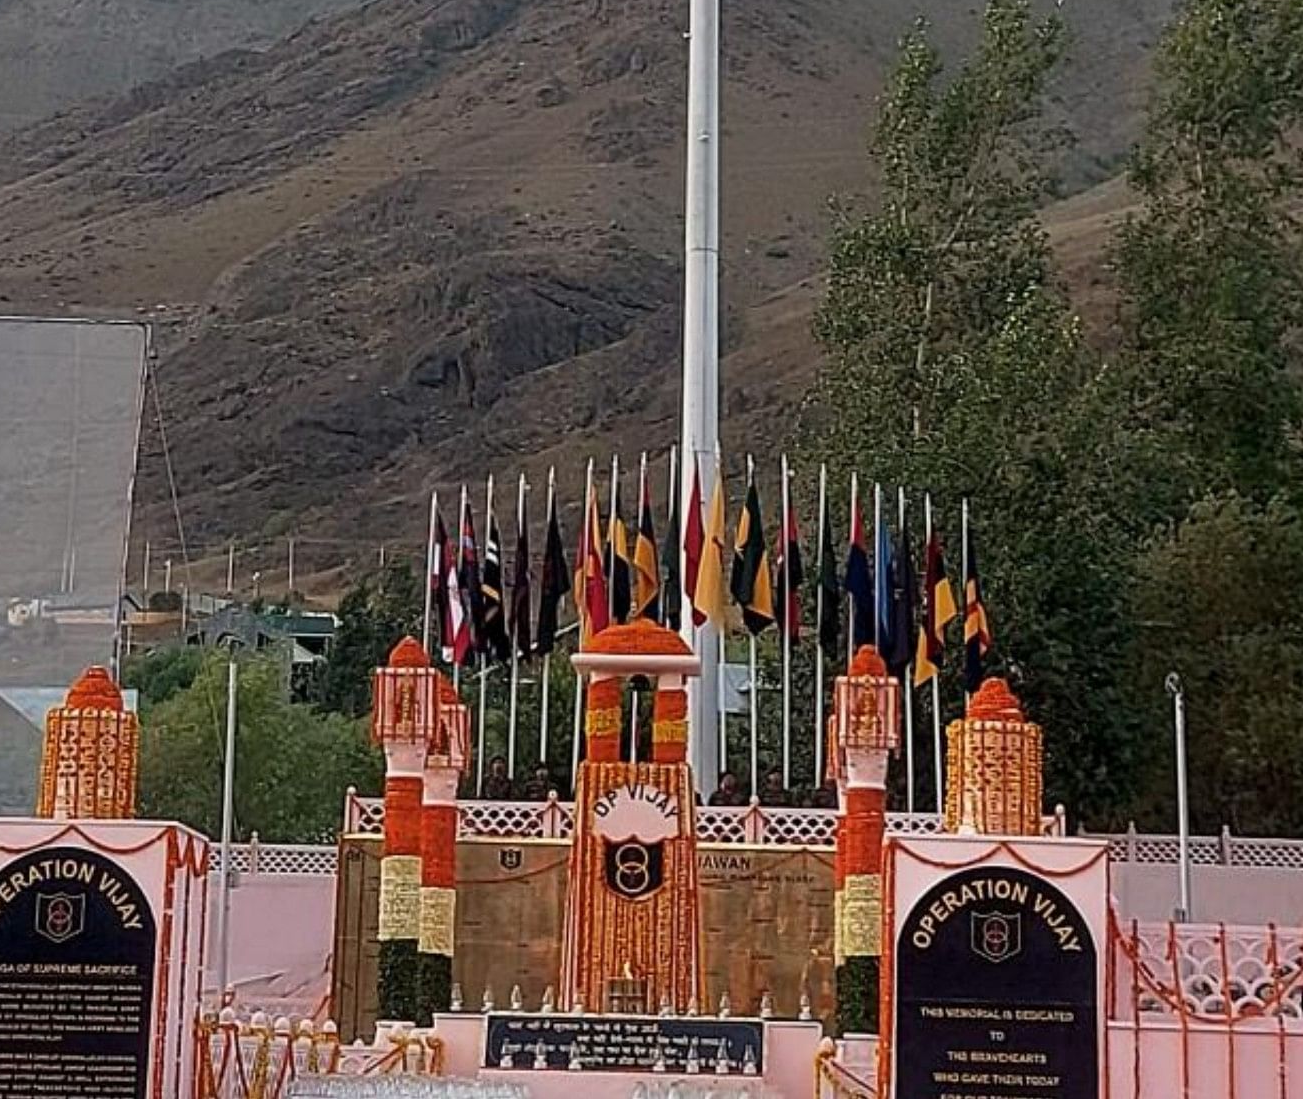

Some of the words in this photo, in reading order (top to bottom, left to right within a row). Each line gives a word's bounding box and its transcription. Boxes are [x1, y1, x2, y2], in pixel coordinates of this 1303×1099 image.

[593, 790, 618, 818] OP
[626, 783, 680, 819] VIJAY
[98, 872, 144, 931] VIJAY
[912, 878, 1029, 950] OPERATION
[1033, 892, 1083, 953] VIJAY
[16, 963, 31, 974] OF
[33, 963, 82, 975] SUPREME
[84, 964, 138, 976] SACRIFICE
[920, 1006, 945, 1019] THIS
[945, 1007, 1001, 1020] MEMORIAL
[1003, 1009, 1013, 1021] IS
[1015, 1009, 1075, 1023] DEDICATED
[989, 1030, 1005, 1042] TO
[947, 1050, 968, 1062] THE
[970, 1051, 1047, 1065] BRAVEHEARTS
[932, 1071, 960, 1083] WHO
[961, 1073, 991, 1085] GAVE
[993, 1074, 1024, 1086] THEIR
[1025, 1075, 1061, 1087] TODAY
